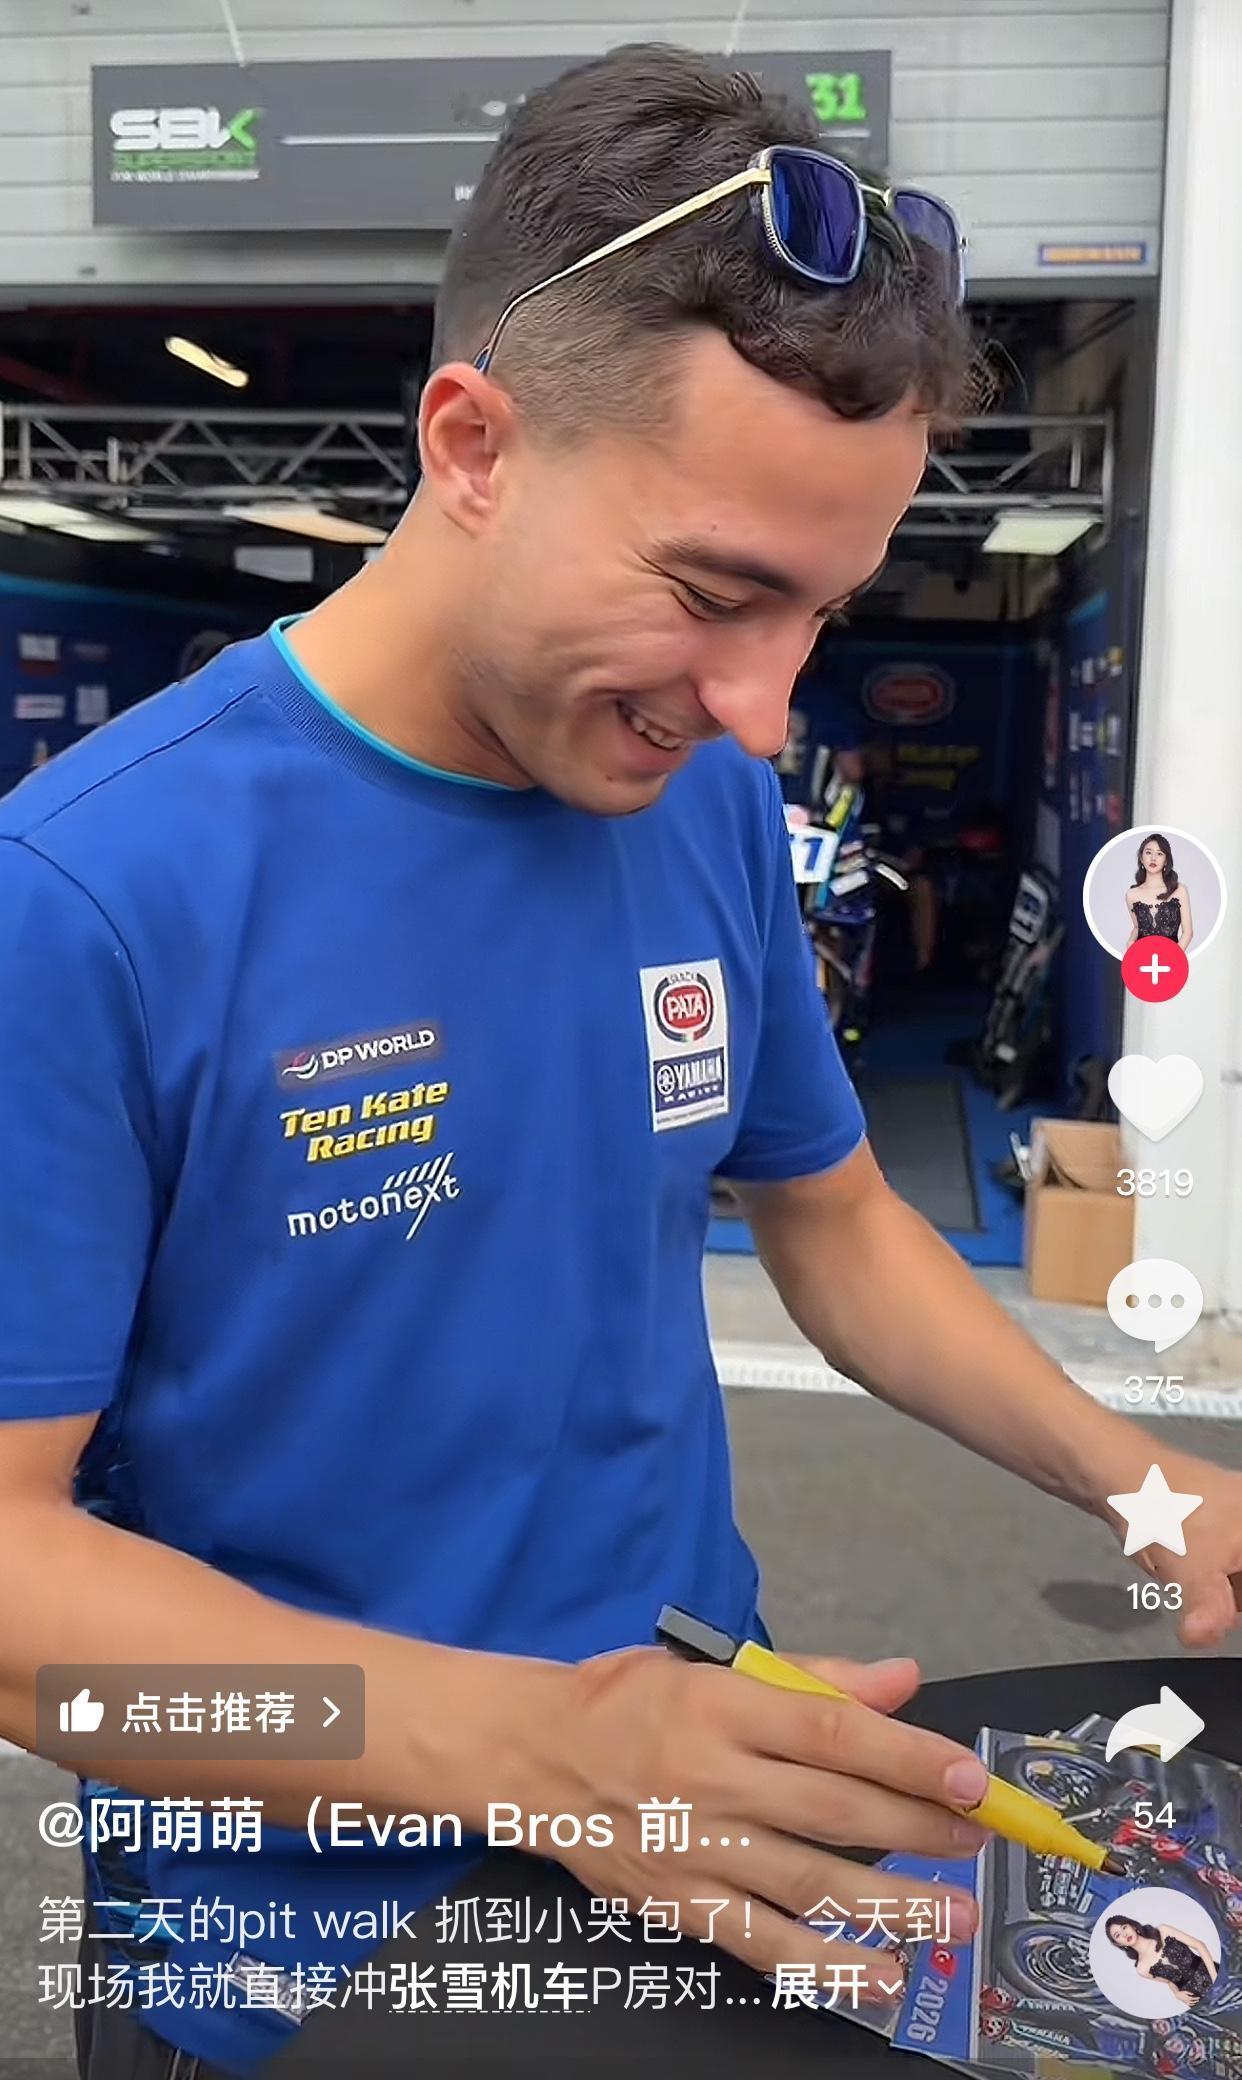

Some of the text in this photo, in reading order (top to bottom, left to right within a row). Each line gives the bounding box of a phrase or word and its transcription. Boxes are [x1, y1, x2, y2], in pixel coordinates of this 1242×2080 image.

[806, 73, 866, 121] 31
[667, 992, 705, 1021] PATA
[321, 1029, 436, 1070] DP WORLD
[279, 1081, 449, 1138] Ten Kate
[306, 1114, 435, 1163] Racing
[287, 1151, 460, 1241] motonext
[906, 1975, 949, 2044] 2026
